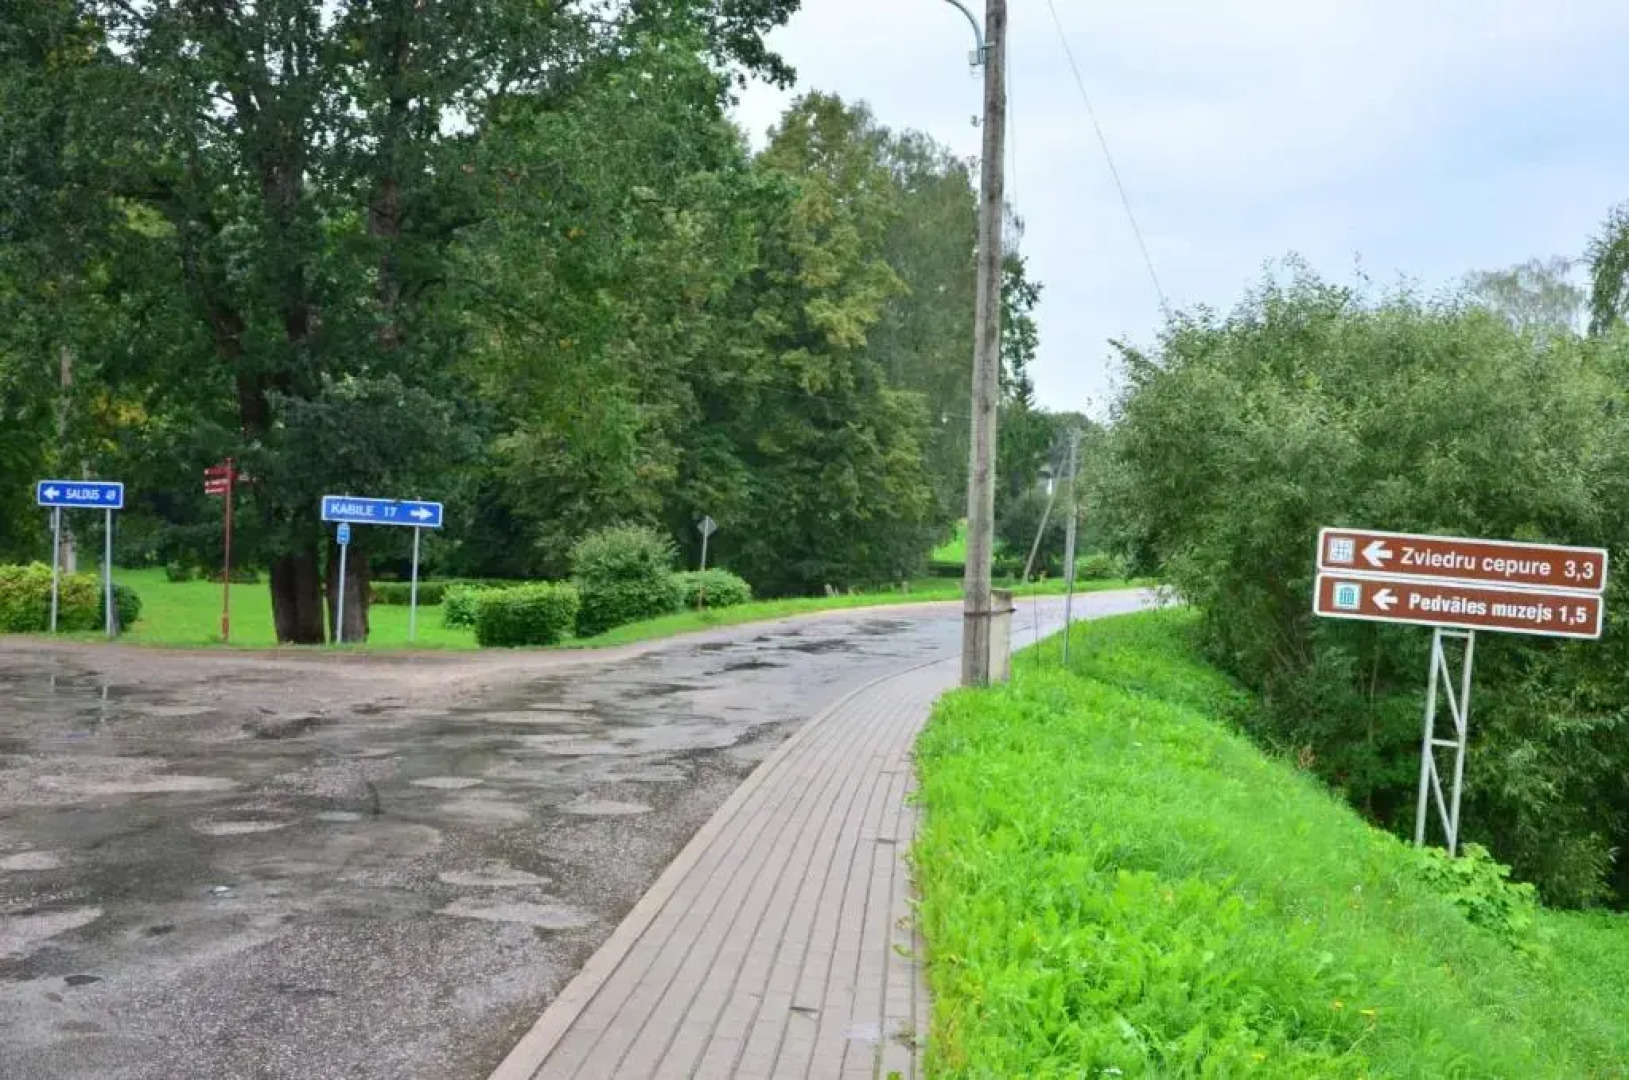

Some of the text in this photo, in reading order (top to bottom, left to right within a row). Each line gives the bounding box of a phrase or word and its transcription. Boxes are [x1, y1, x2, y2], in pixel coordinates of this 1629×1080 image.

[331, 503, 397, 518] KABILE 17
[1400, 547, 1594, 581] Zviedru cepure 3,3
[1409, 592, 1587, 625] Pedvāles muzejs 1,5
